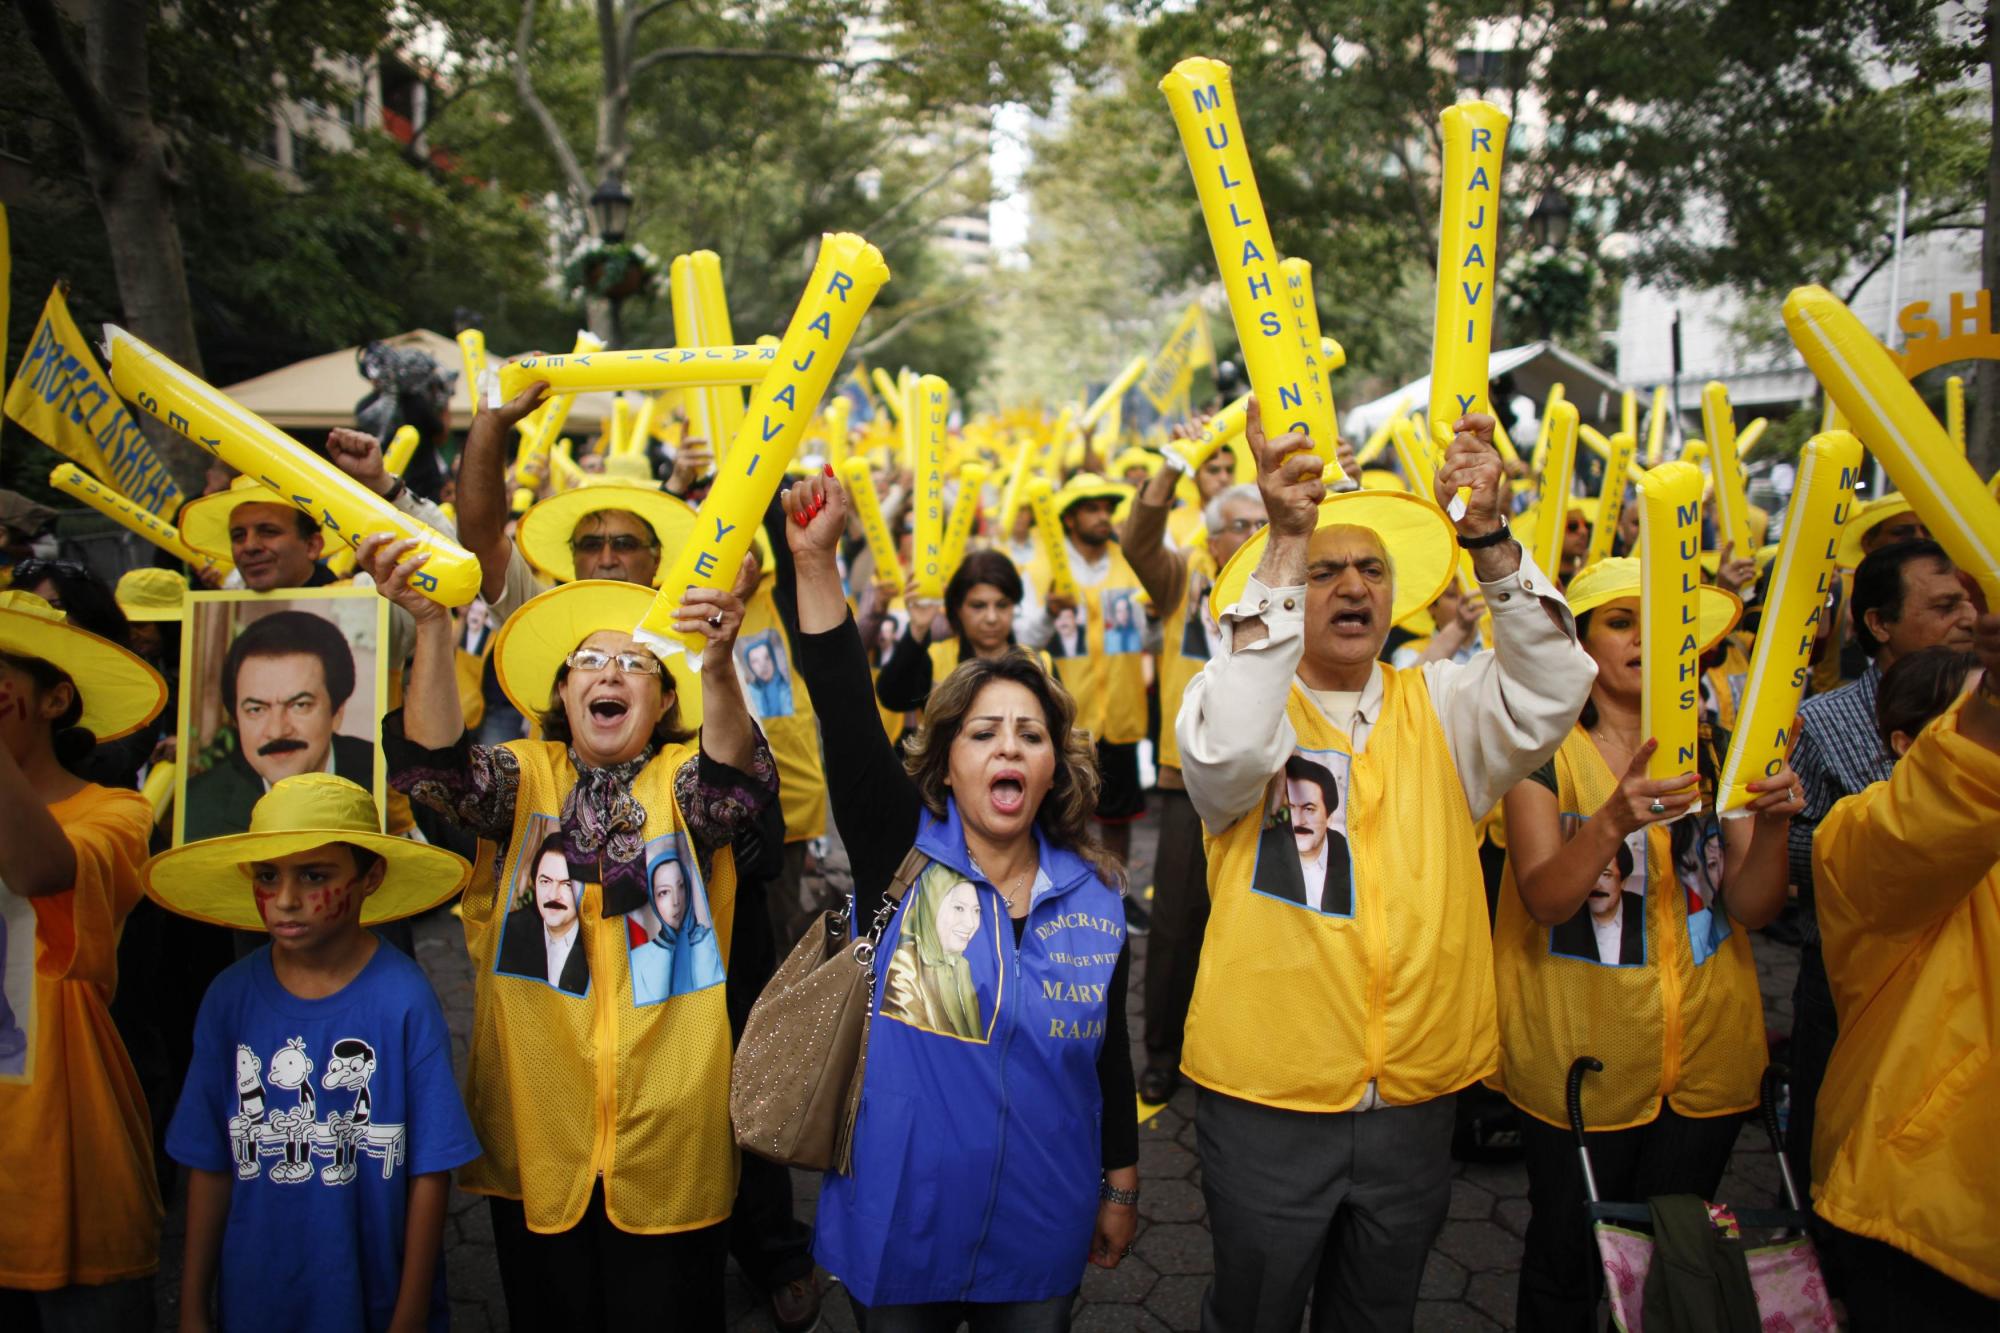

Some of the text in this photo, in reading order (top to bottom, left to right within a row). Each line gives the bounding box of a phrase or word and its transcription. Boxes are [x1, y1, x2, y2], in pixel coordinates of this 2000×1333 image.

[1192, 84, 1282, 337] MULLAHS
[1463, 128, 1492, 343] RAJAVI
[520, 348, 776, 369] RAJAVI YES
[686, 271, 854, 589] RAJAVI YE
[1288, 275, 1323, 404] MULLAHS
[69, 473, 175, 539] MULLAHS
[138, 391, 438, 592] RAVI YES
[926, 391, 942, 576] MULLAHS NO
[1677, 500, 1698, 710] MULLAHS
[1765, 466, 1858, 777] MULLAHS NO
[1035, 912, 1121, 940] DEMCRATIC
[1041, 980, 1105, 1003] MARY
